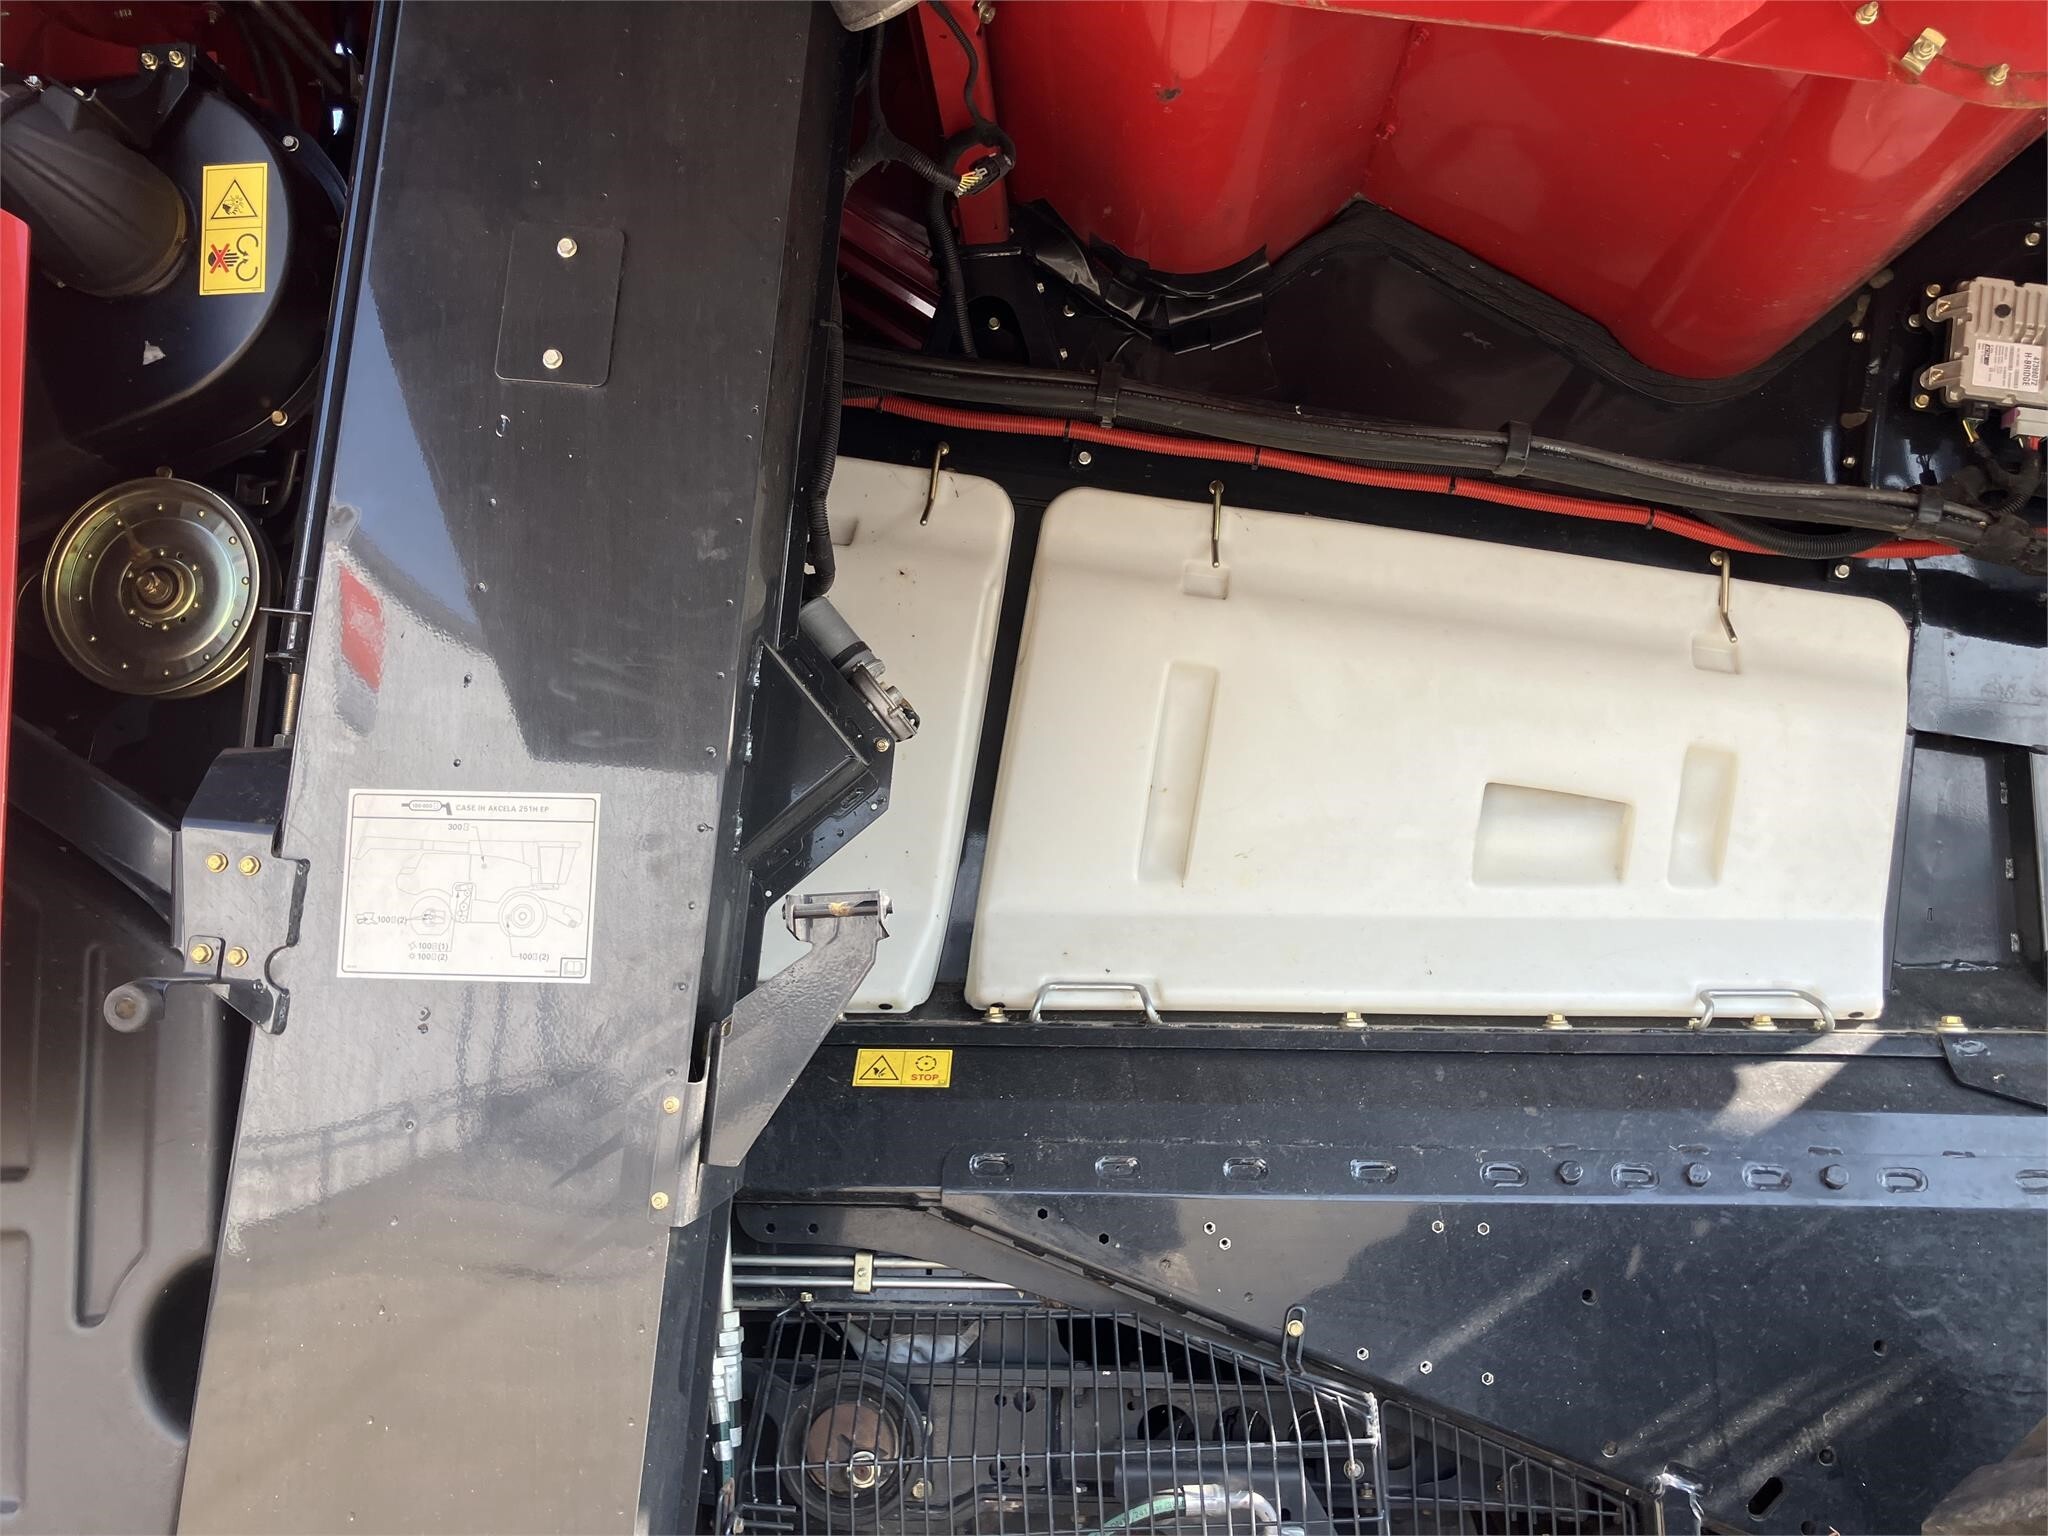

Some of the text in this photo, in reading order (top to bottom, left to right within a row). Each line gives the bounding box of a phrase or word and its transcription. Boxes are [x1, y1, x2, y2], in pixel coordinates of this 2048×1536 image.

[455, 804, 476, 812] CASE
[478, 804, 486, 812] IH
[488, 805, 517, 813] AKCELA
[519, 805, 538, 813] 251H
[447, 823, 463, 831] 300
[911, 1073, 939, 1081] STOP
